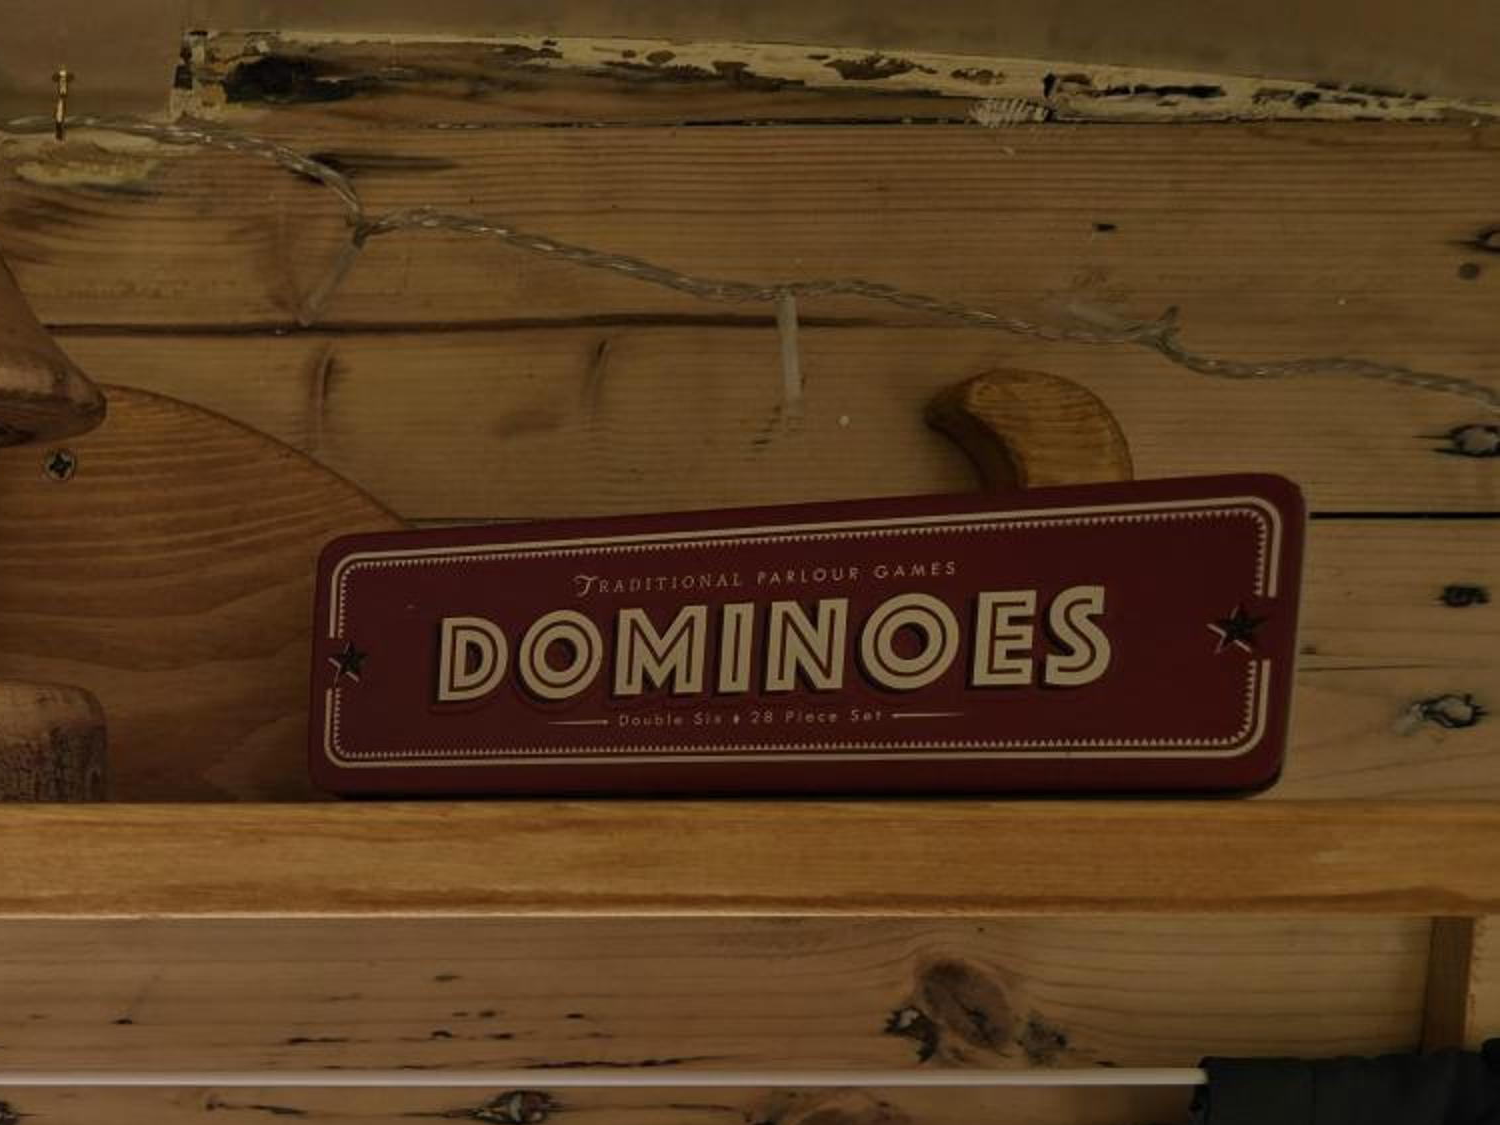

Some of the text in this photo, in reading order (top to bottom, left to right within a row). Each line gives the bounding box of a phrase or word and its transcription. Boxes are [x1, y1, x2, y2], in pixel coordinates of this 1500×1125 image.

[572, 560, 958, 598] TRADITIONAL PARLOUR GAMES
[436, 584, 1113, 704] DOMINOES
[618, 710, 684, 728] Double
[750, 710, 773, 725] 28
[784, 709, 838, 725] Piece
[850, 708, 882, 723] Set
